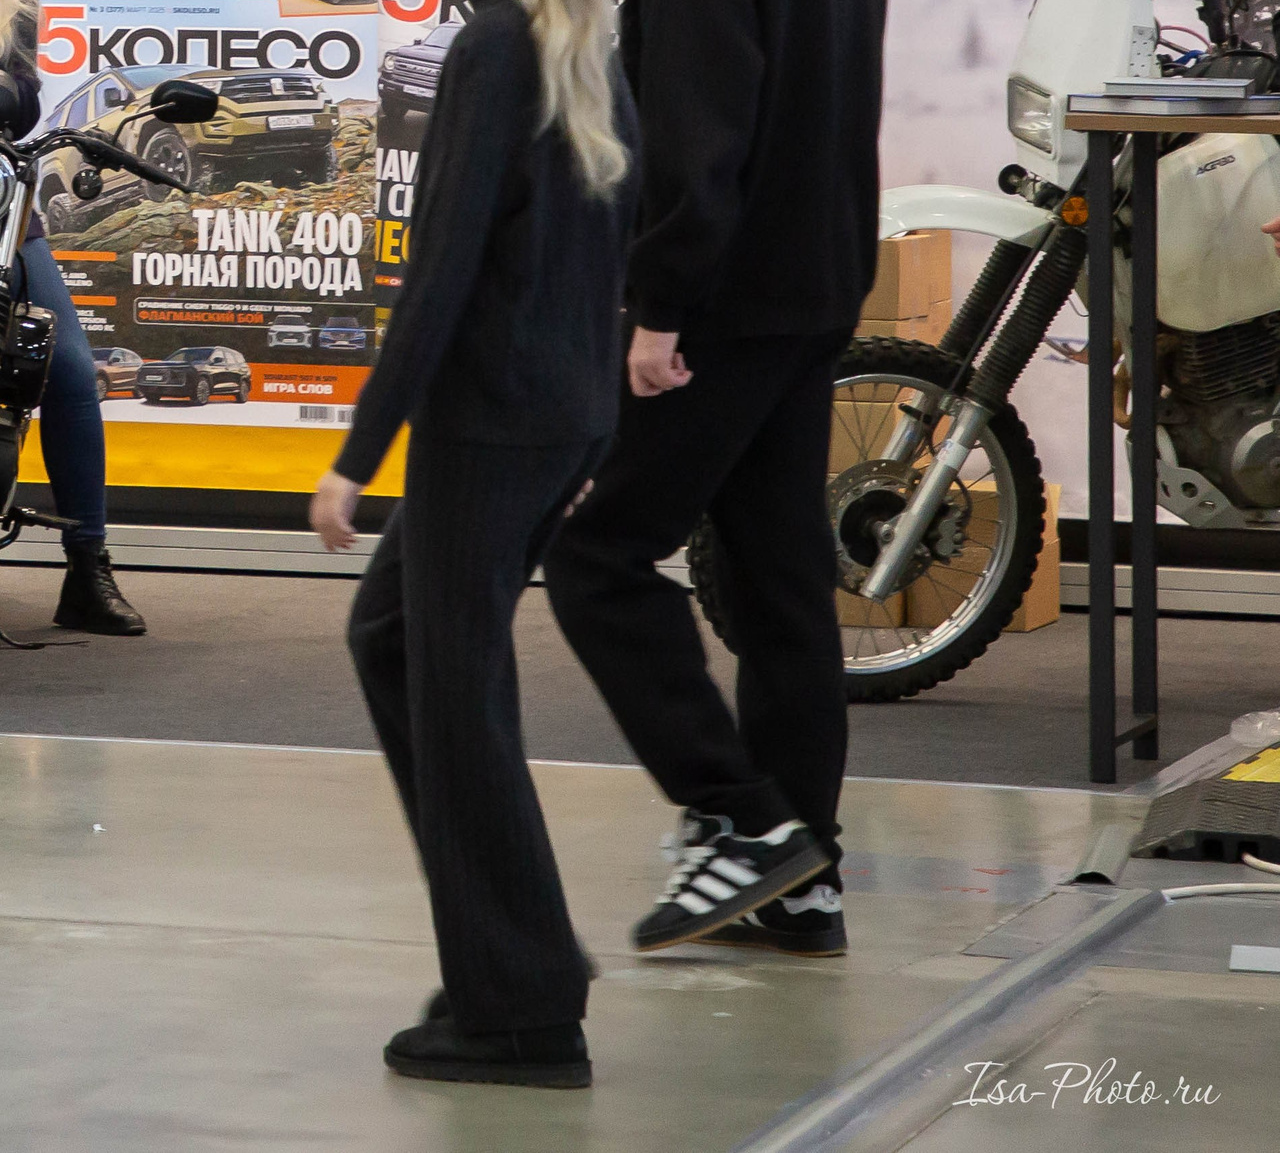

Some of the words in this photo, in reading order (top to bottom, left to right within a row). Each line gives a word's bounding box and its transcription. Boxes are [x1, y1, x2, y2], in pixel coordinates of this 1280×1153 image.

[193, 207, 285, 254] TANK
[292, 212, 363, 257] 400
[132, 252, 239, 287] ГОРНАЯ
[245, 255, 364, 297] ПОРОДА
[138, 310, 235, 323] ФЛАГМАНСКИЙ
[237, 312, 265, 324] БОЙ
[263, 382, 297, 394] ИГРА
[297, 383, 334, 395] СЛОВ
